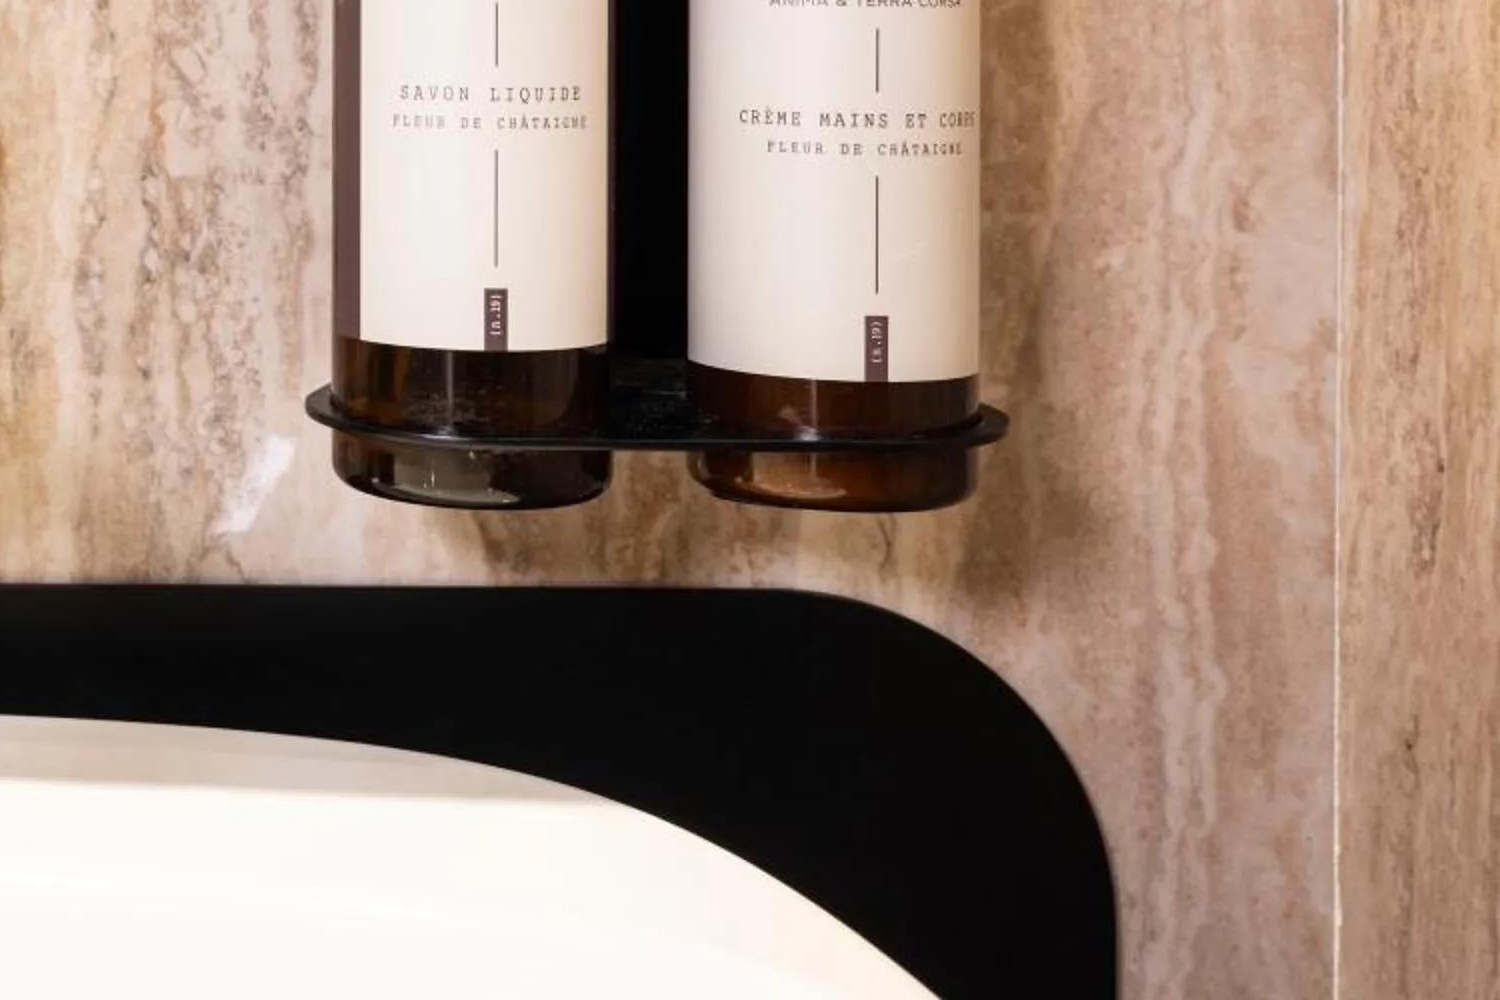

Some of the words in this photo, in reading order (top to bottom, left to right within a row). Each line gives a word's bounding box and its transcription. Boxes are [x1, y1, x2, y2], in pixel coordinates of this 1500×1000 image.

[399, 85, 469, 101] SAVON
[490, 86, 581, 104] LIQUIDE
[393, 113, 445, 129] FLEUR
[461, 116, 481, 129] DE
[739, 105, 801, 126] CRÈME
[819, 112, 888, 129] MAINS
[905, 112, 927, 129] ET
[767, 140, 823, 155] FLEUR
[841, 142, 862, 156] DE
